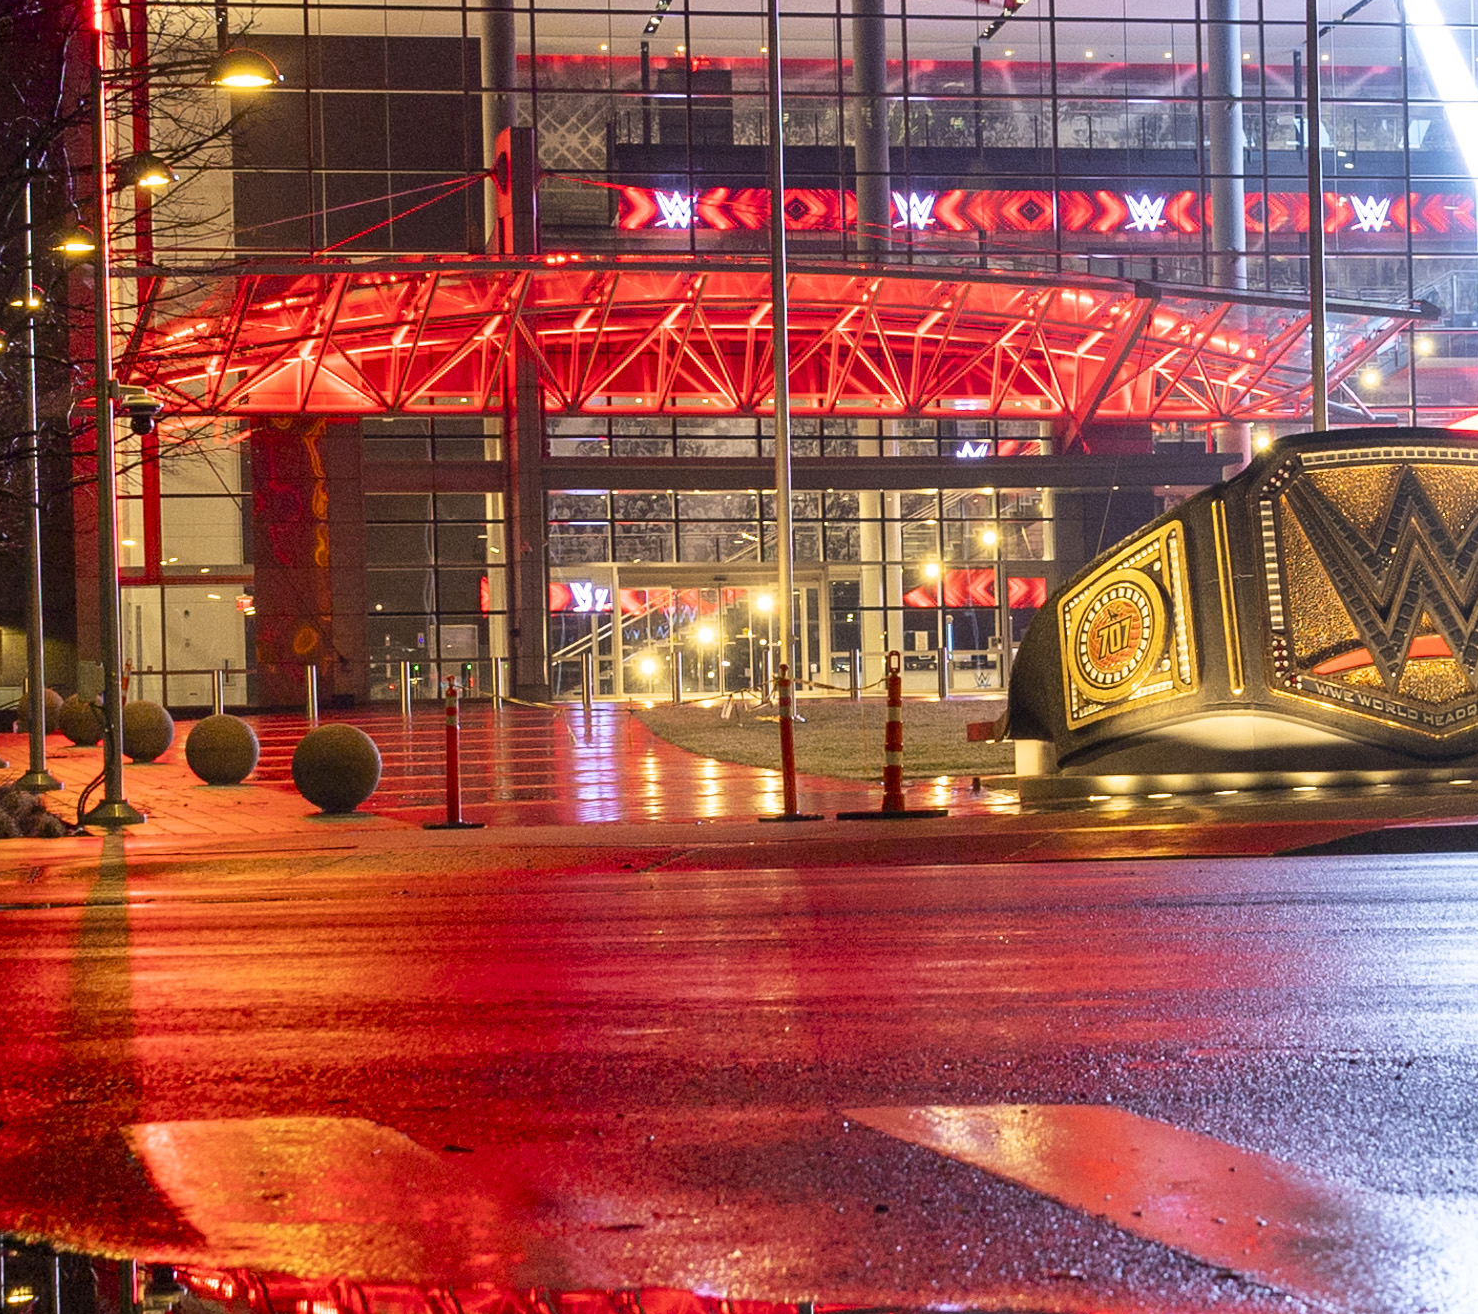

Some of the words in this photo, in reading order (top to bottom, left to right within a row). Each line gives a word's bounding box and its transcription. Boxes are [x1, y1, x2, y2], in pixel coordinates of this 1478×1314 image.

[1097, 615, 1132, 660] 707
[1315, 682, 1355, 704] WWE
[1357, 690, 1420, 722] WORLD
